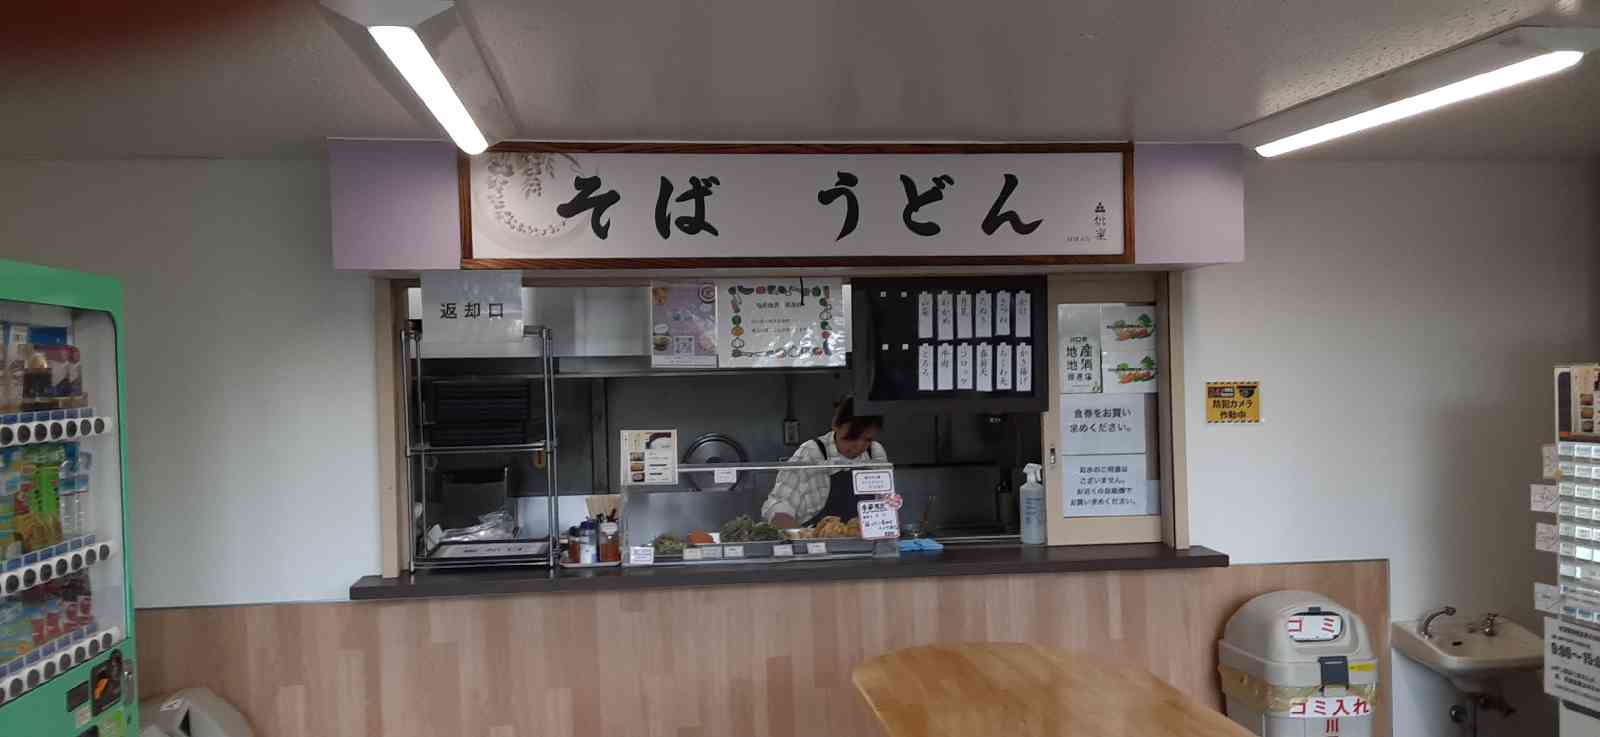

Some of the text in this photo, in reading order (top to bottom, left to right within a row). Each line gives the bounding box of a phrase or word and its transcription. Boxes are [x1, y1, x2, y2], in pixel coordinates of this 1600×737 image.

[556, 171, 1044, 242] そば うどん
[440, 302, 504, 319] 返却口
[1212, 399, 1255, 409] 防犯カメラ
[1074, 407, 1132, 419] 食券をお買い
[1069, 422, 1132, 433] 求めください。
[1291, 697, 1370, 716] ゴミ入れ
[1326, 718, 1340, 737] 川
